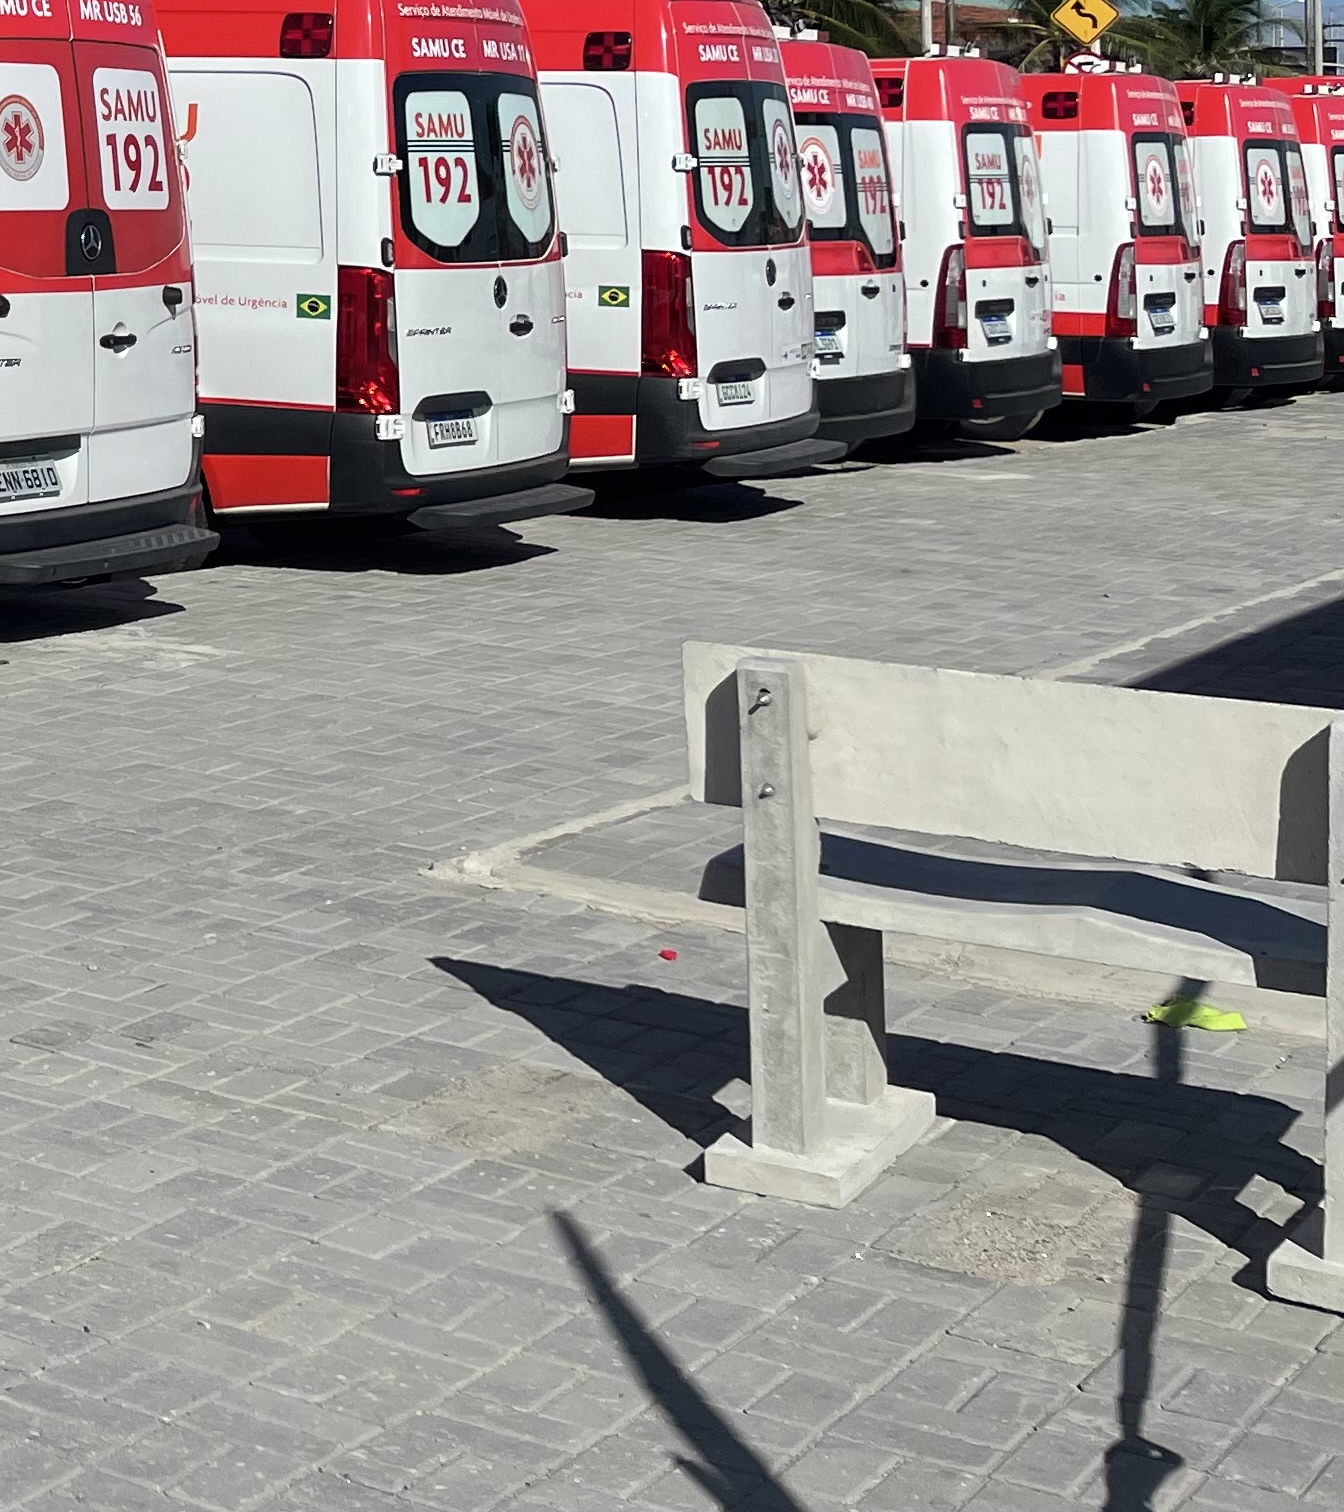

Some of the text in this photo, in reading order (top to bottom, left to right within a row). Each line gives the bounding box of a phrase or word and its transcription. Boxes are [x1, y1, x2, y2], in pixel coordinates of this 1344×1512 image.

[104, 0, 129, 25] USB
[129, 4, 143, 27] 56
[397, 2, 430, 20] Serviço
[430, 2, 441, 17] de
[412, 37, 467, 58] SAMU CE
[483, 39, 499, 58] MR
[698, 44, 740, 62] SAMU CE
[100, 87, 157, 123] SAMU
[790, 88, 831, 105] SAMU CE
[414, 111, 465, 138] SAMU
[704, 128, 742, 150] SAMU
[106, 133, 163, 193] 192
[857, 149, 881, 169] SAMU
[975, 153, 1002, 170] SAMU
[418, 156, 472, 205] 192
[707, 166, 749, 206] 192
[861, 174, 887, 215] 192
[978, 178, 1006, 210] 192
[195, 293, 288, 309] óvel de Urgência
